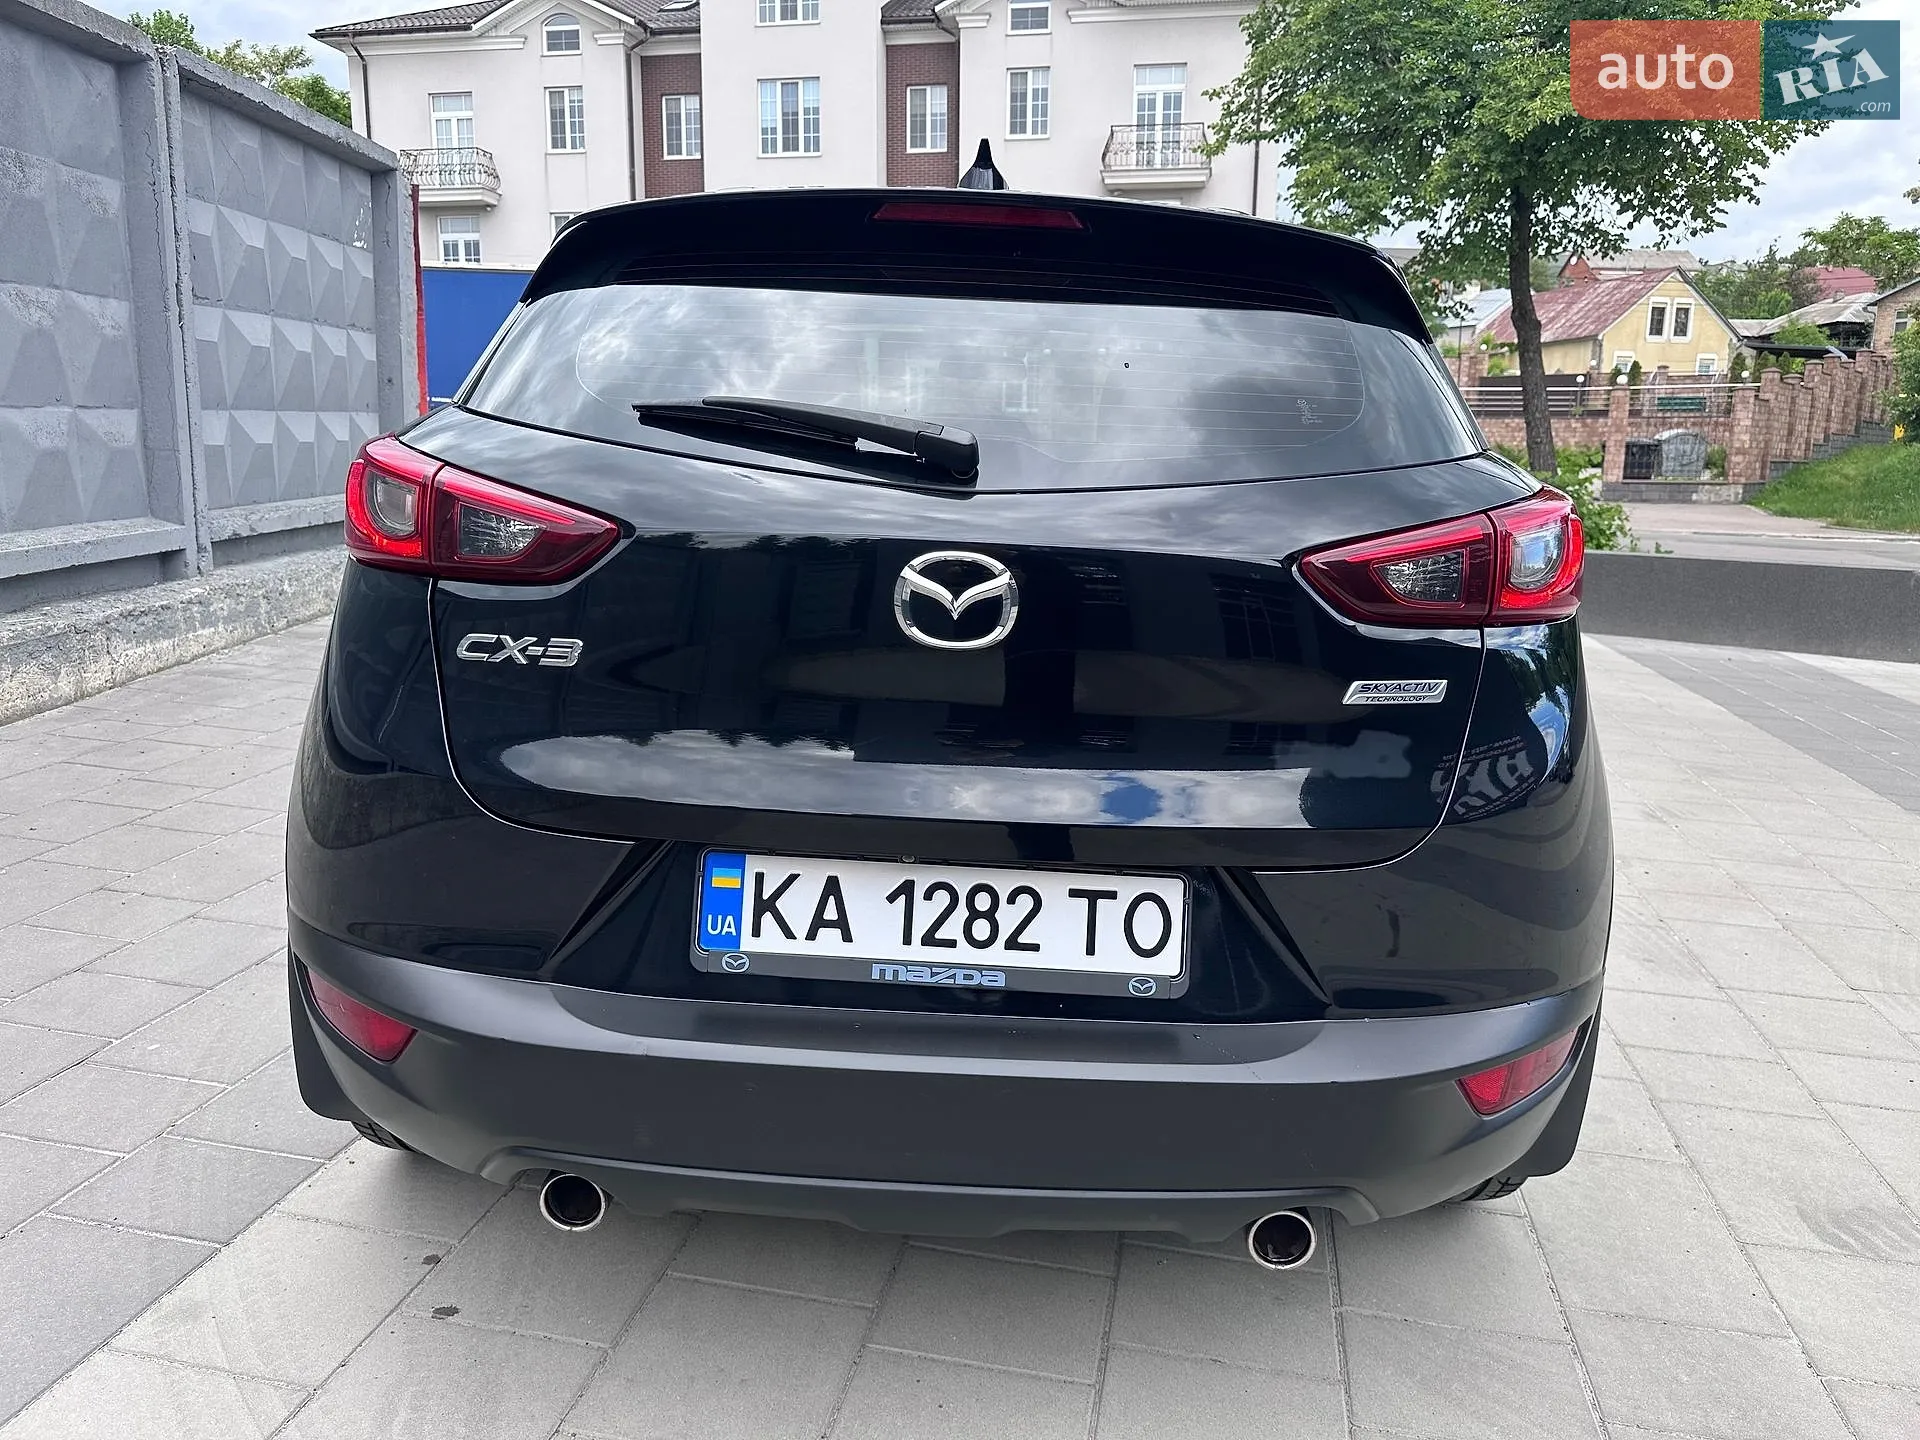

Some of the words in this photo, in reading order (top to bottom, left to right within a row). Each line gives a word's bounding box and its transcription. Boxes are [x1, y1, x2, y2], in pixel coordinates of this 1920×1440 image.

[456, 633, 584, 667] CX-3
[1358, 682, 1440, 693] SKYACTIV
[1365, 695, 1428, 703] TECHNOLOGY
[706, 914, 737, 936] UA
[751, 871, 854, 943] KA
[885, 879, 1041, 952] 1282
[1067, 887, 1172, 959] TO
